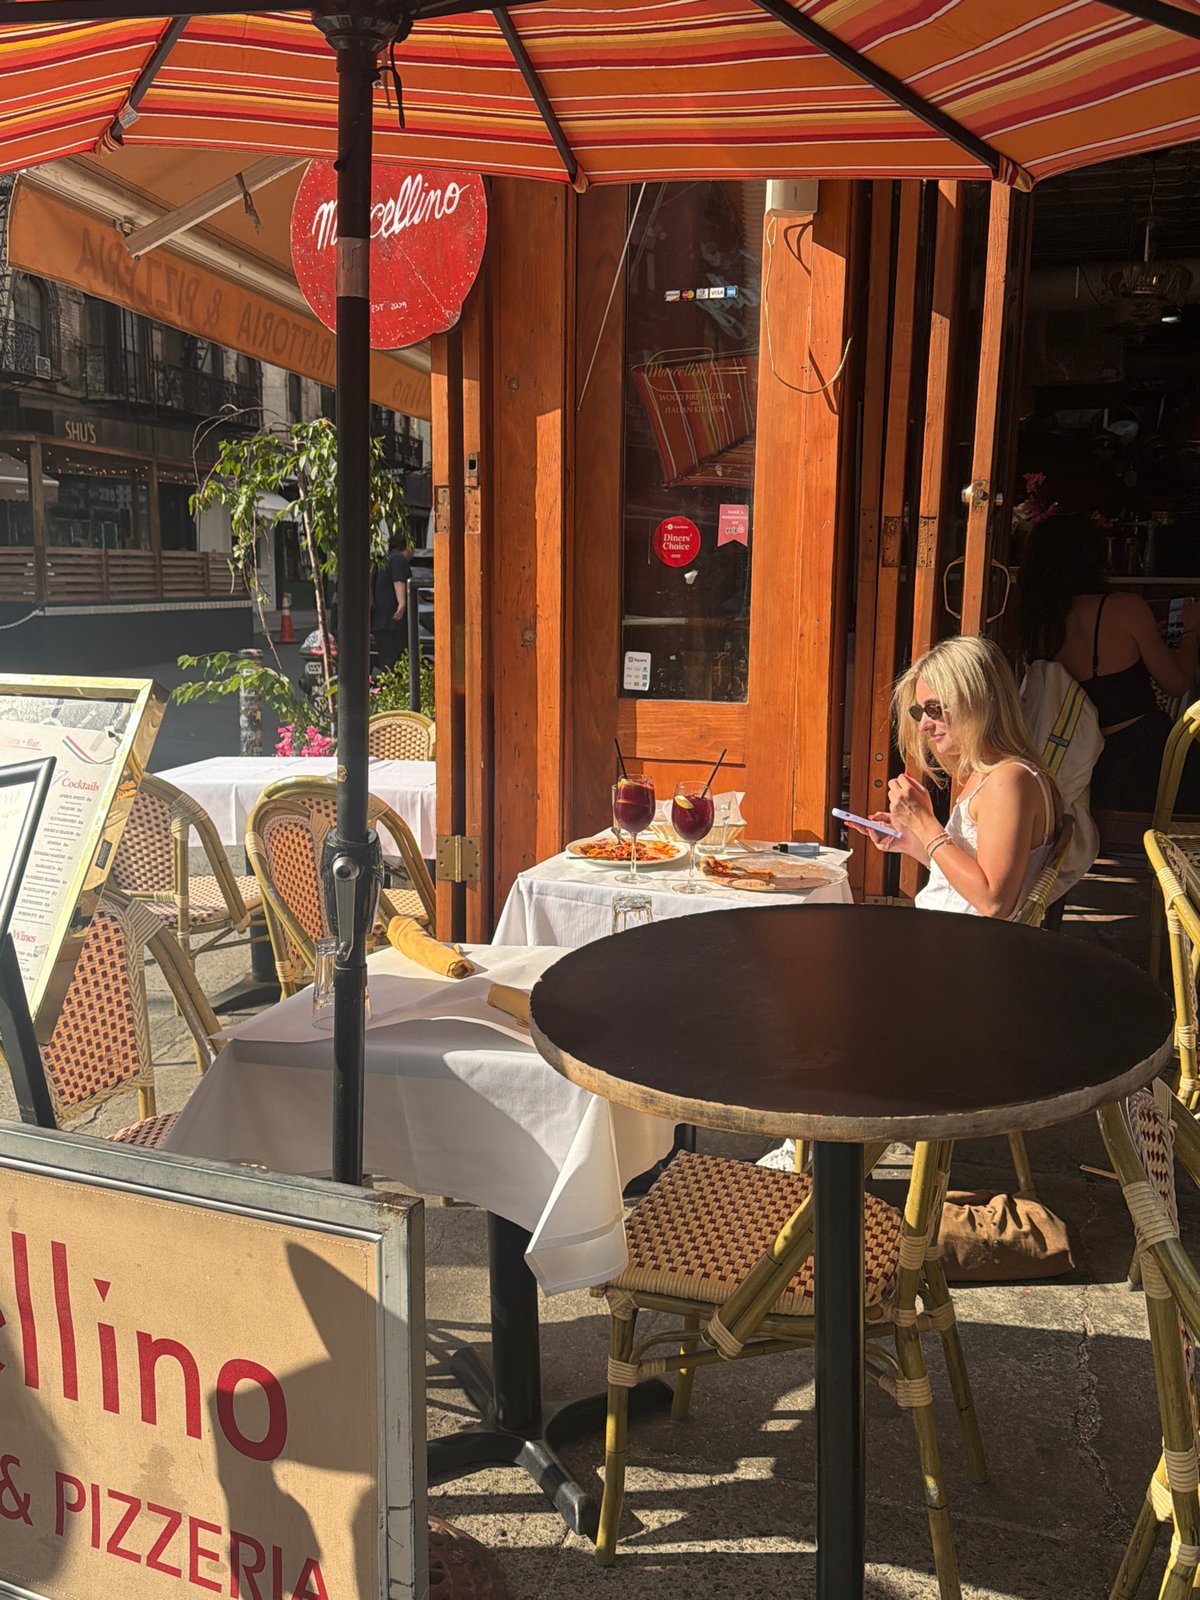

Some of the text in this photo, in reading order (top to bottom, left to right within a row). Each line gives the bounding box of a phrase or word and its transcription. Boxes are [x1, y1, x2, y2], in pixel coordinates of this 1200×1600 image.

[311, 173, 470, 250] Mcellino
[65, 420, 97, 444] SHU'S
[662, 542, 690, 551] Choice
[61, 778, 100, 791] Cocktails
[12, 929, 37, 943] Wines
[0, 1231, 288, 1462] llino
[55, 1471, 329, 1600] PIZZERIA
